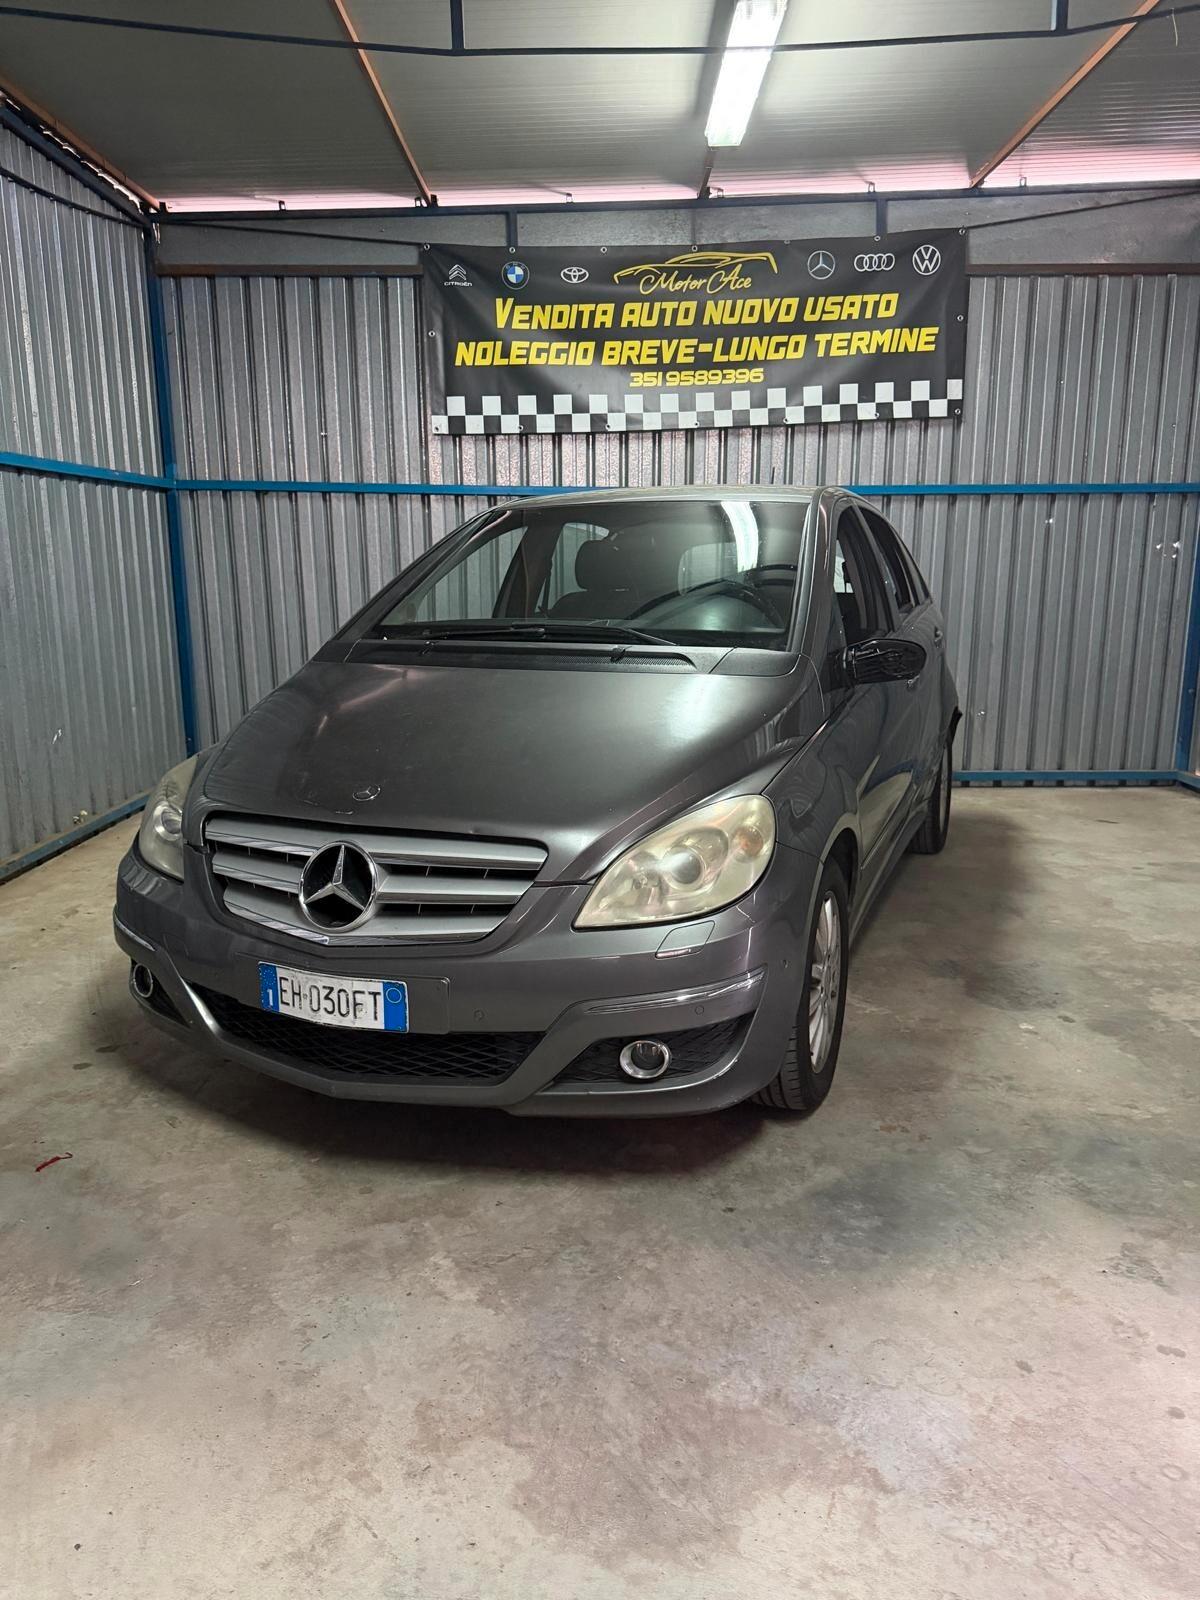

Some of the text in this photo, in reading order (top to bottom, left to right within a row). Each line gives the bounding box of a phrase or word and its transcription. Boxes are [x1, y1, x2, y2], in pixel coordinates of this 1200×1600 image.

[640, 263, 752, 295] Motor Ace
[495, 292, 899, 330] VENDITA AUTO NUOVO USATO
[454, 326, 939, 367] NOLEGGIO BREVE-LUNGO TERMINE
